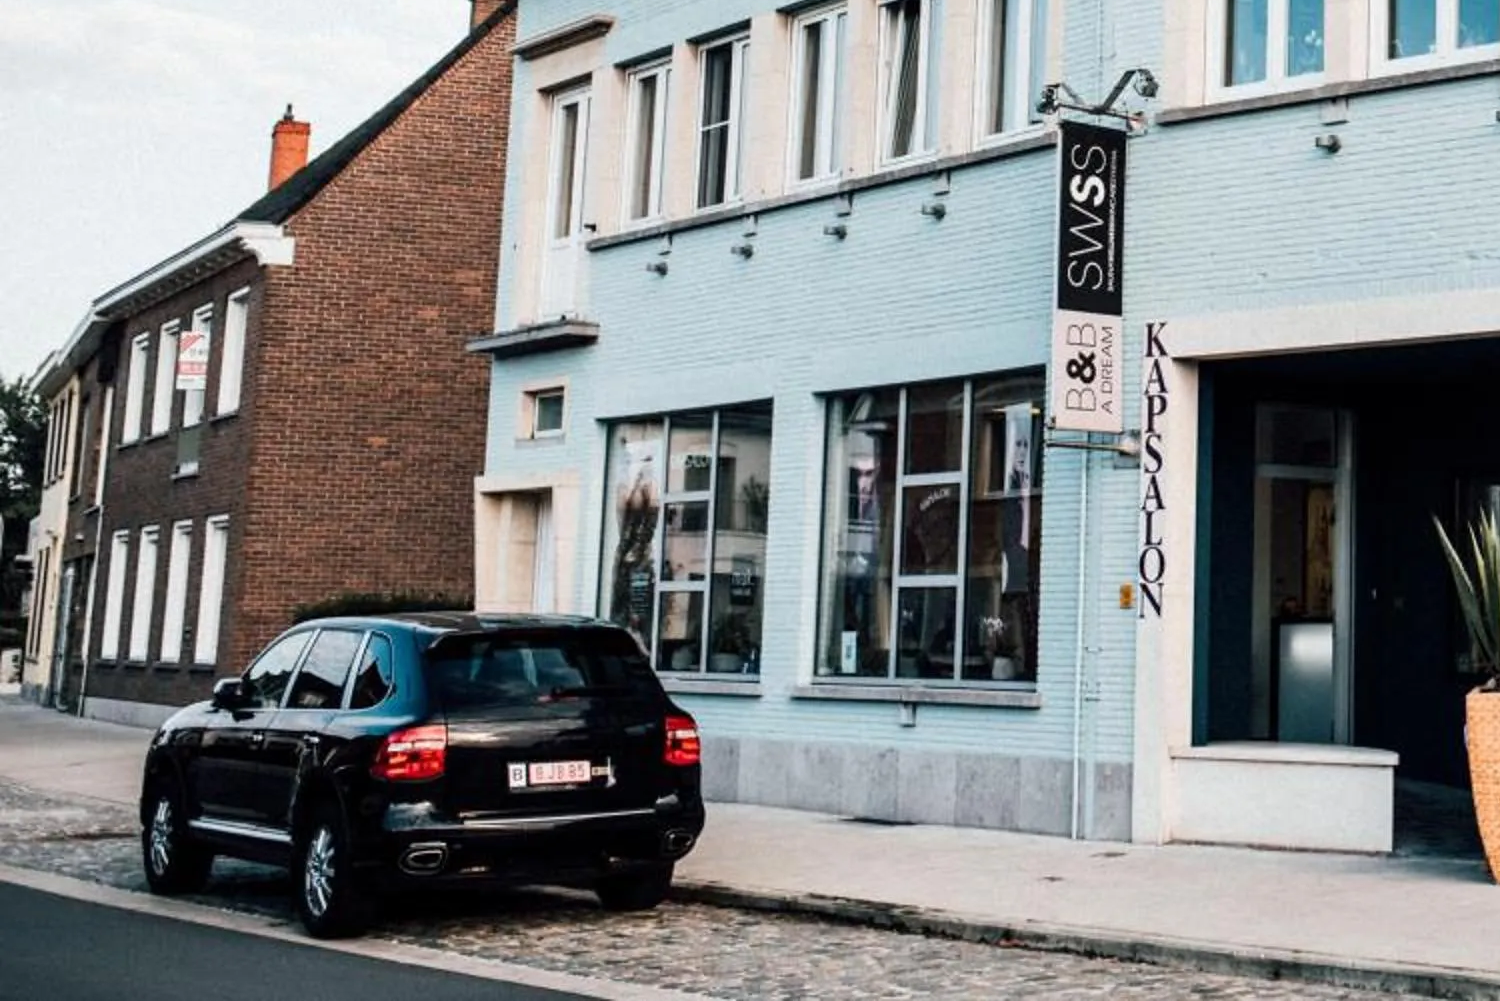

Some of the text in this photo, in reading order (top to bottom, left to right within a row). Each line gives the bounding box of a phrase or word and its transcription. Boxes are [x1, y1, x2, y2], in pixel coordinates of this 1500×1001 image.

[1067, 144, 1107, 290] SWSS
[1066, 323, 1097, 412] B&B
[1101, 326, 1113, 415] A DREAM
[1139, 321, 1168, 619] KAPSALON
[512, 768, 523, 781] B
